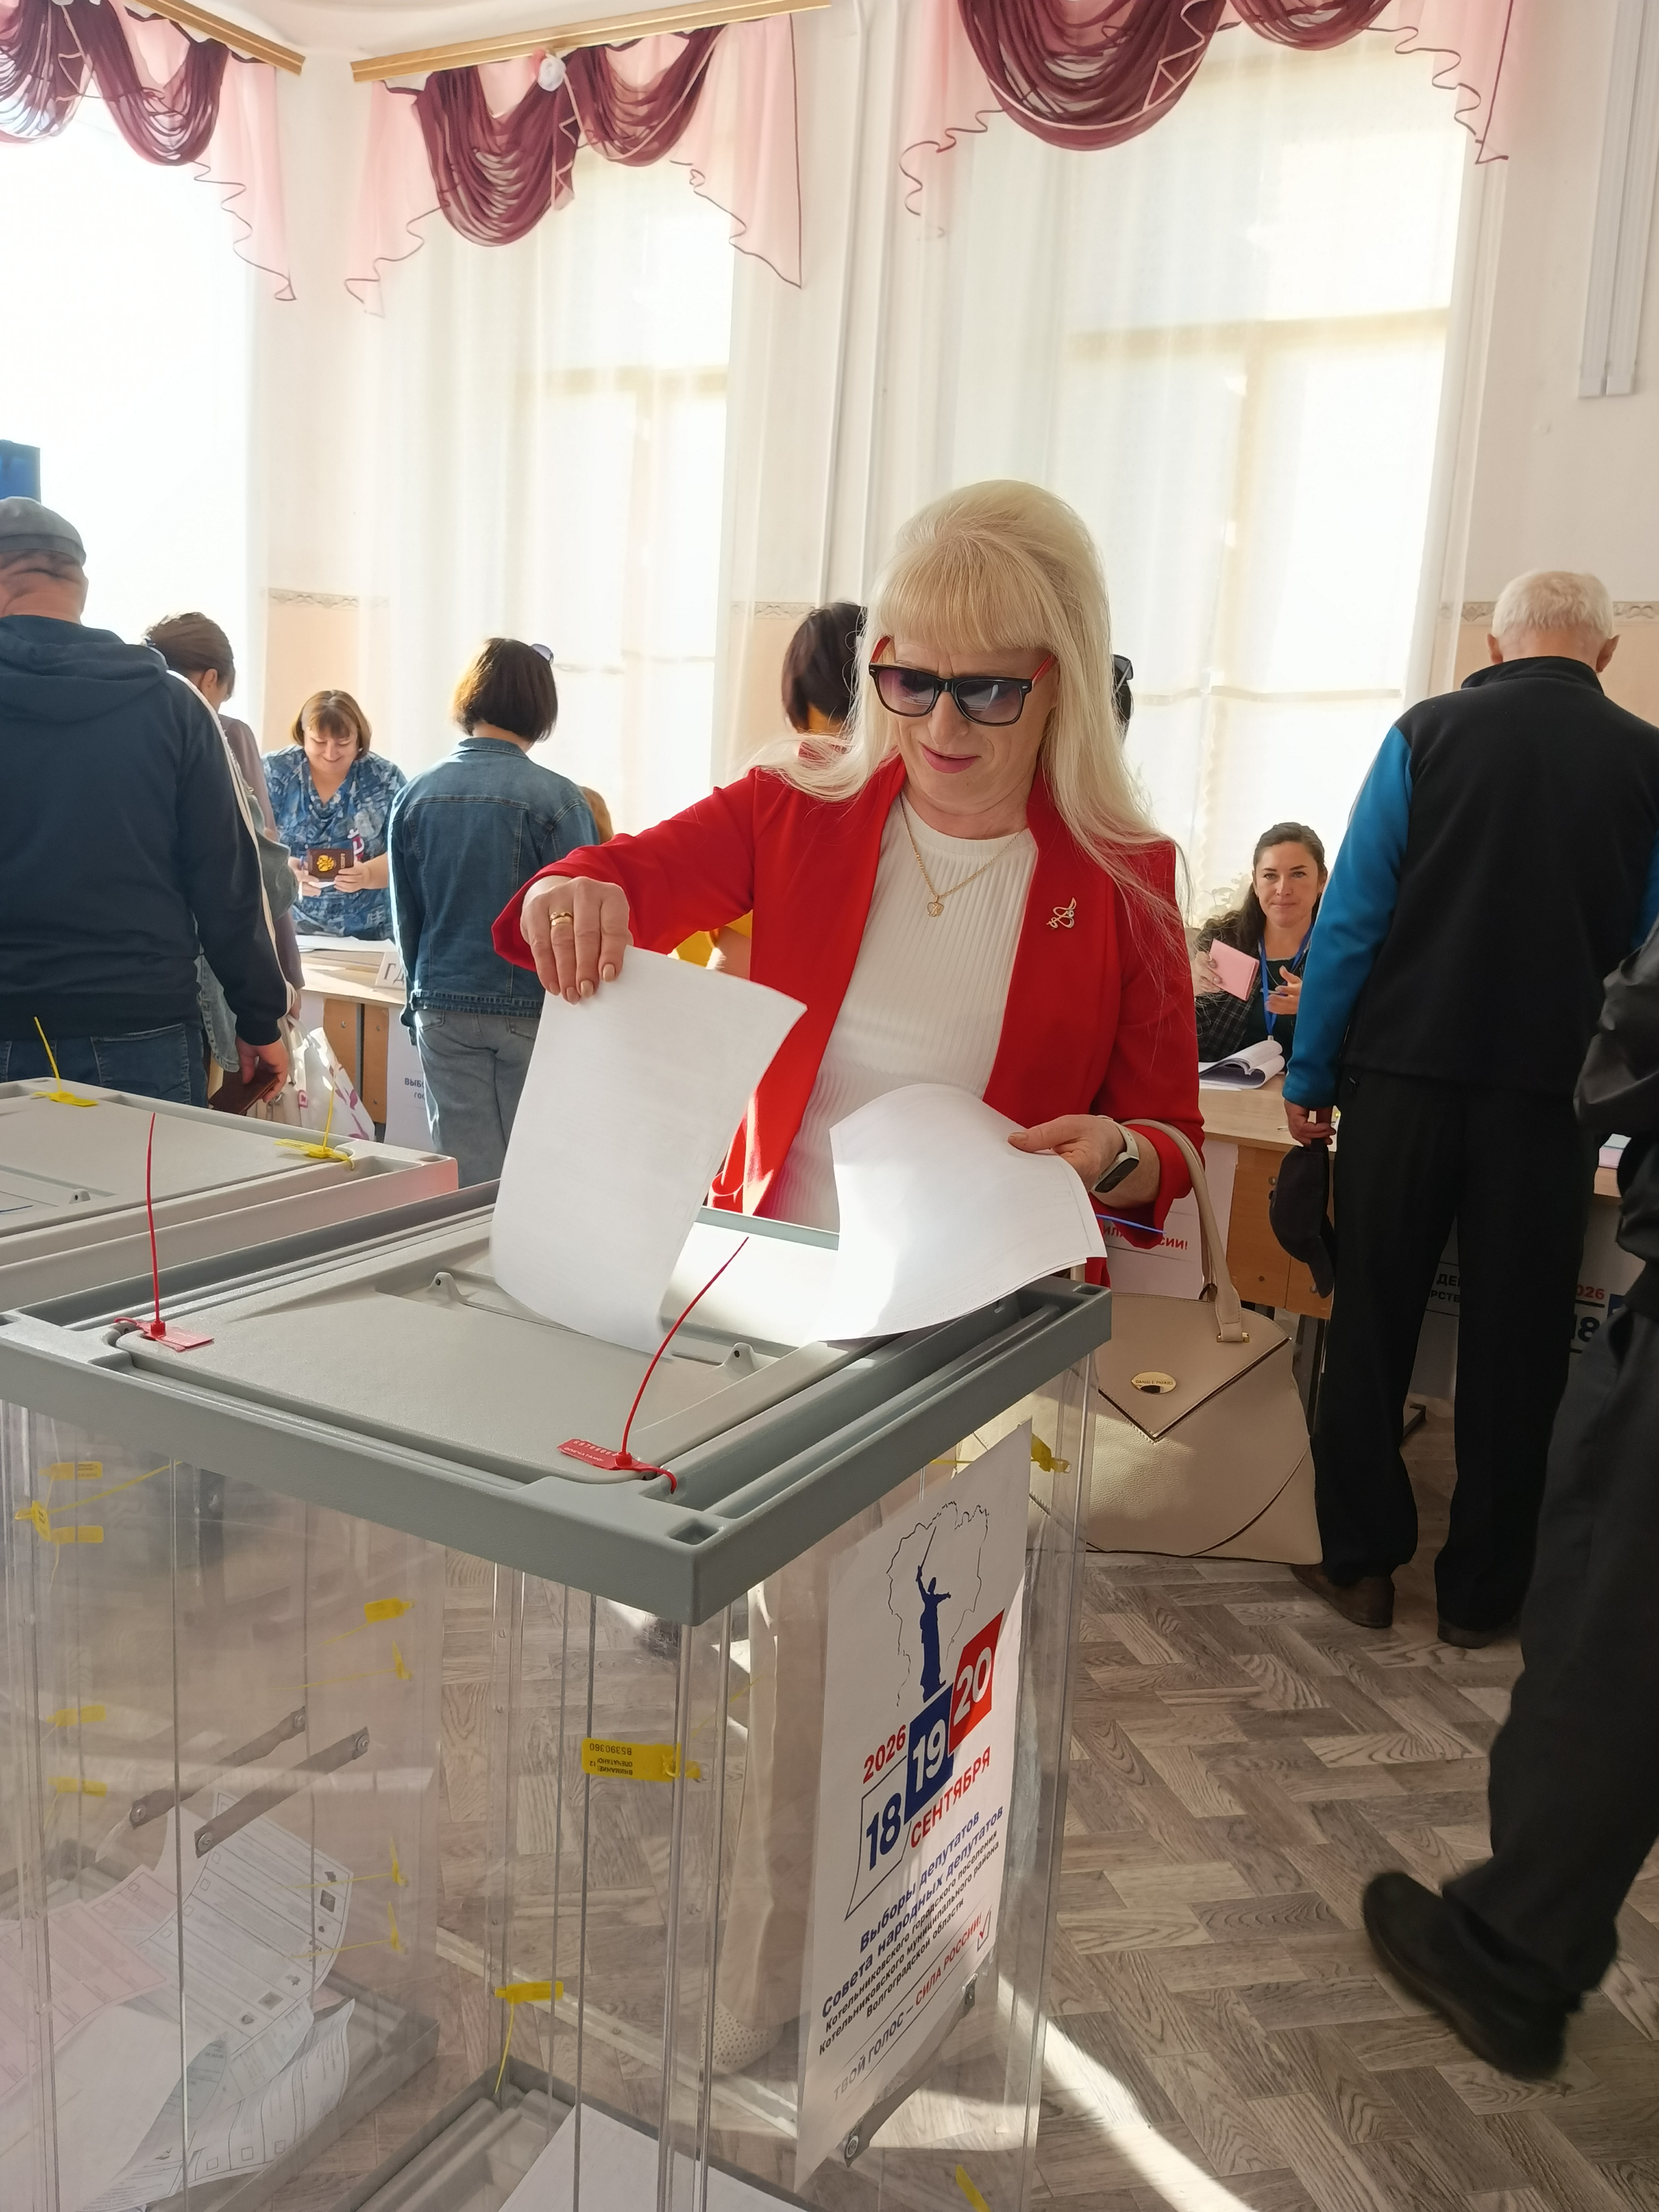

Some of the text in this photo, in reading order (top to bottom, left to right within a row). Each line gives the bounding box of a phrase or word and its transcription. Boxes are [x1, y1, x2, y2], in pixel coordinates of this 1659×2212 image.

[953, 1646, 992, 1727] 20
[863, 1724, 906, 1784] 2026
[911, 1745, 991, 1847] СЕНТЯБРЯ
[913, 1719, 946, 1793] 19
[860, 1811, 979, 1953] Выборы депутатов
[867, 1793, 901, 1871] 18
[819, 1841, 999, 2057] Котельниковского муниципального района
[822, 1805, 1003, 2018] Совета народных депутатов
[826, 1829, 998, 2033] Котельниковского городского поселения
[867, 1898, 963, 2019] Волгоградской области
[834, 2054, 865, 2102] ТВОЙ
[868, 2012, 904, 2063] ГОЛОС
[915, 1966, 941, 2006] СИЛА
[943, 1911, 982, 1971] РОССИИ!
